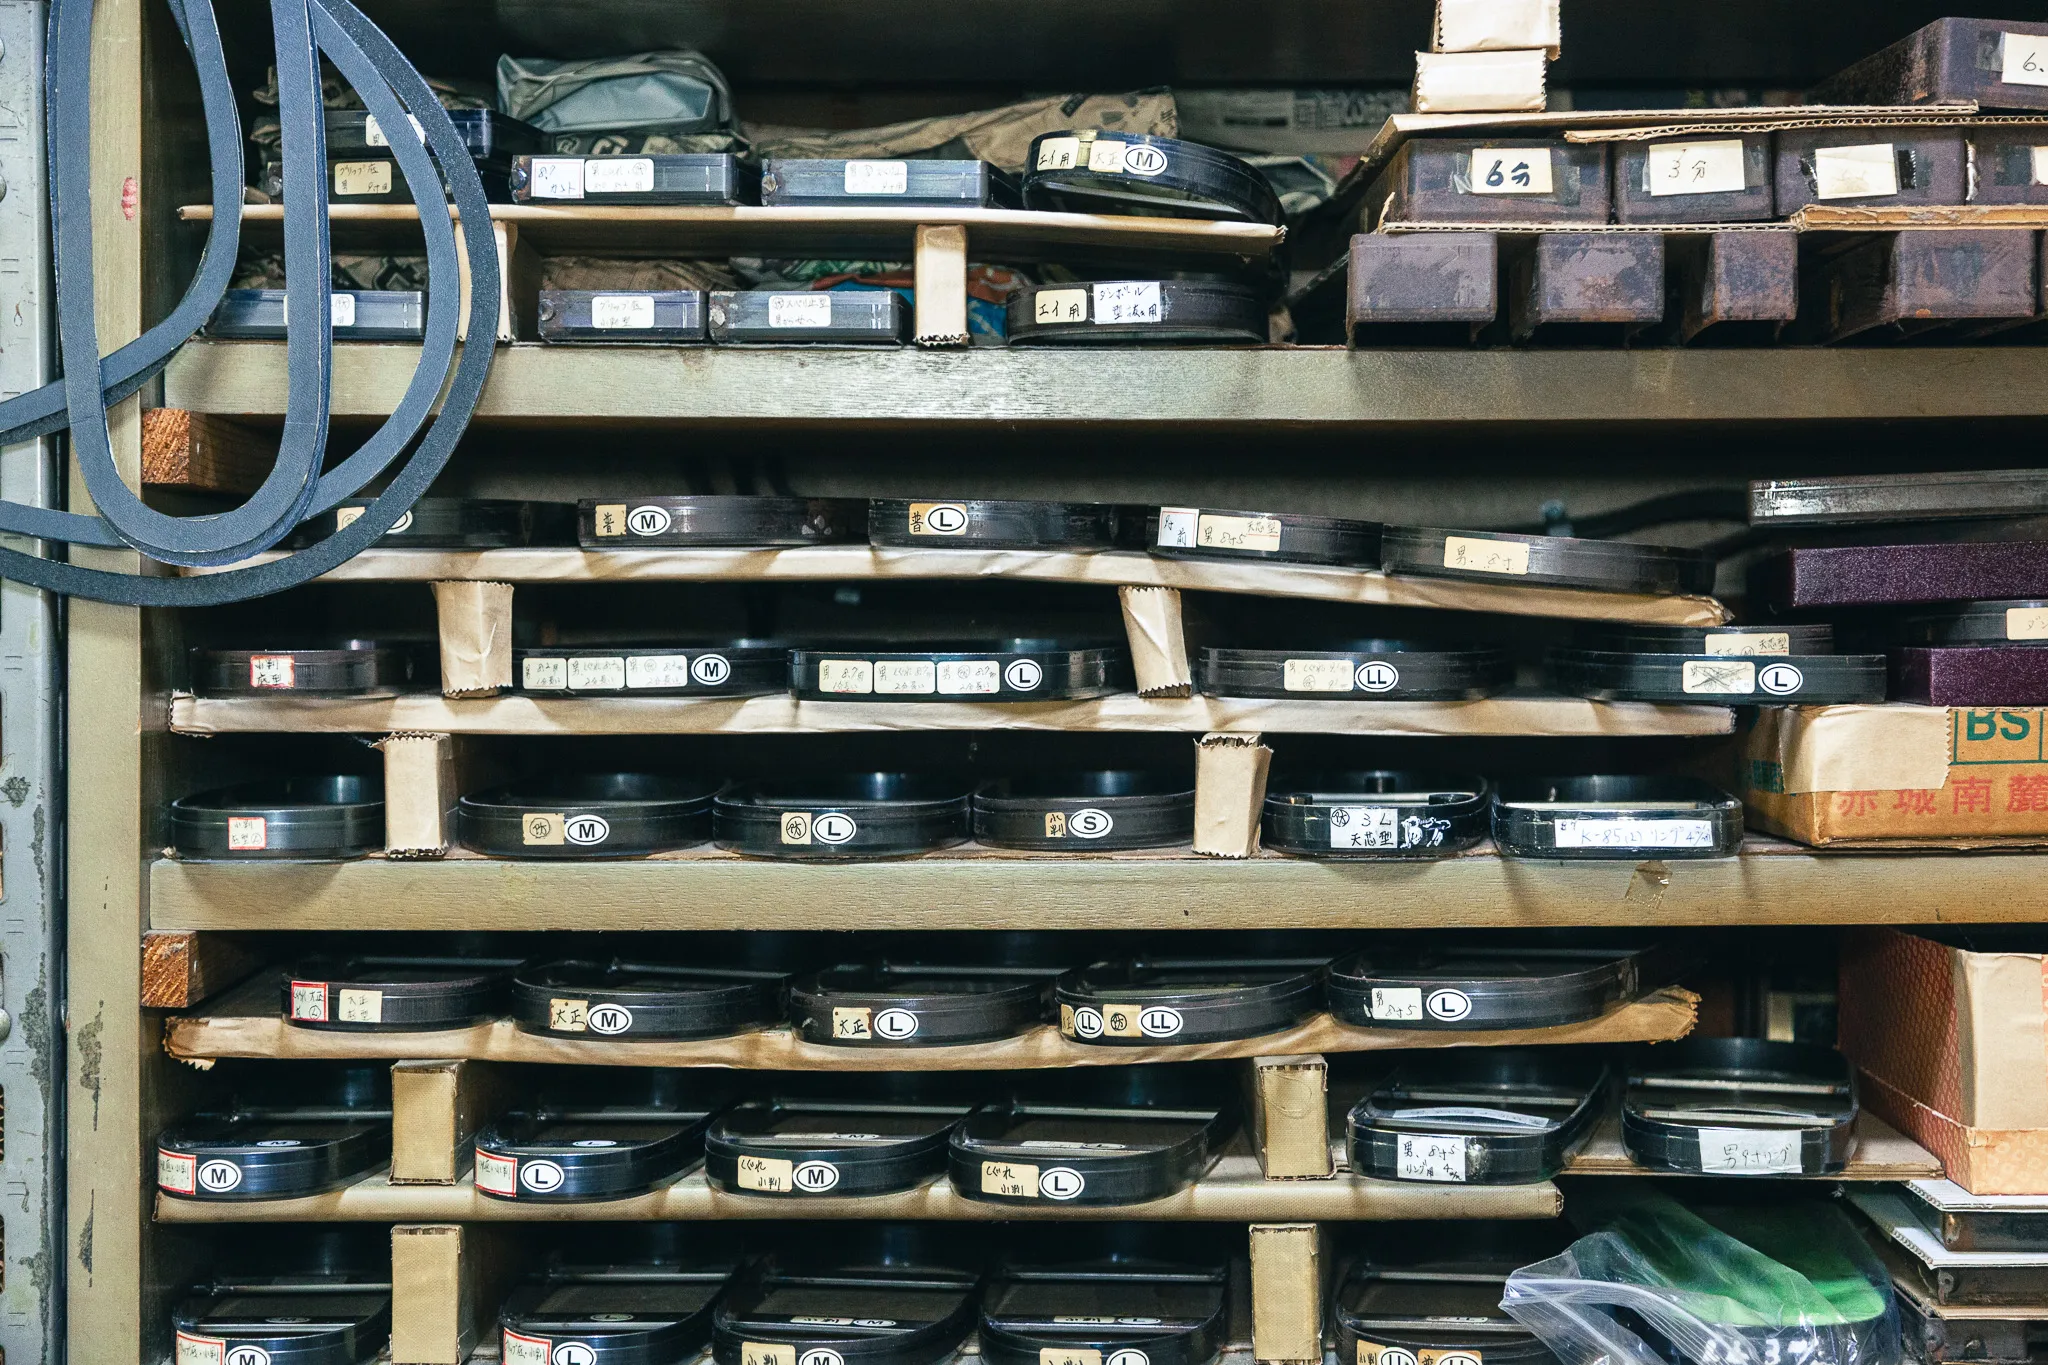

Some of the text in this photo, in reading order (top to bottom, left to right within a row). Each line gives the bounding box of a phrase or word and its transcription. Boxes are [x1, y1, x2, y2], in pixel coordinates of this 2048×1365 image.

[1136, 151, 1154, 169] M
[1669, 158, 1707, 182] 3分
[641, 515, 656, 530] M
[940, 512, 953, 527] L
[704, 662, 719, 677] M
[1019, 668, 1031, 684] L
[1367, 669, 1387, 685] LL
[1775, 671, 1788, 687] L
[1966, 711, 2031, 741] BS
[579, 823, 595, 838] M
[828, 821, 841, 836] L
[1084, 816, 1097, 831] S
[1351, 832, 1394, 847] 天芯型
[1441, 997, 1456, 1013] L
[556, 1009, 586, 1025] 大正
[601, 1012, 617, 1028] M
[890, 1016, 903, 1032] L
[1081, 1013, 1096, 1031] LL
[1151, 1014, 1171, 1029] LL
[839, 1019, 867, 1035] 大正
[211, 1168, 227, 1183] M
[535, 1169, 549, 1184] L
[808, 1169, 825, 1185] M
[1054, 1175, 1068, 1191] L
[758, 1177, 781, 1191] 小判
[1001, 1183, 1024, 1197] 小判
[239, 1354, 256, 1365] M
